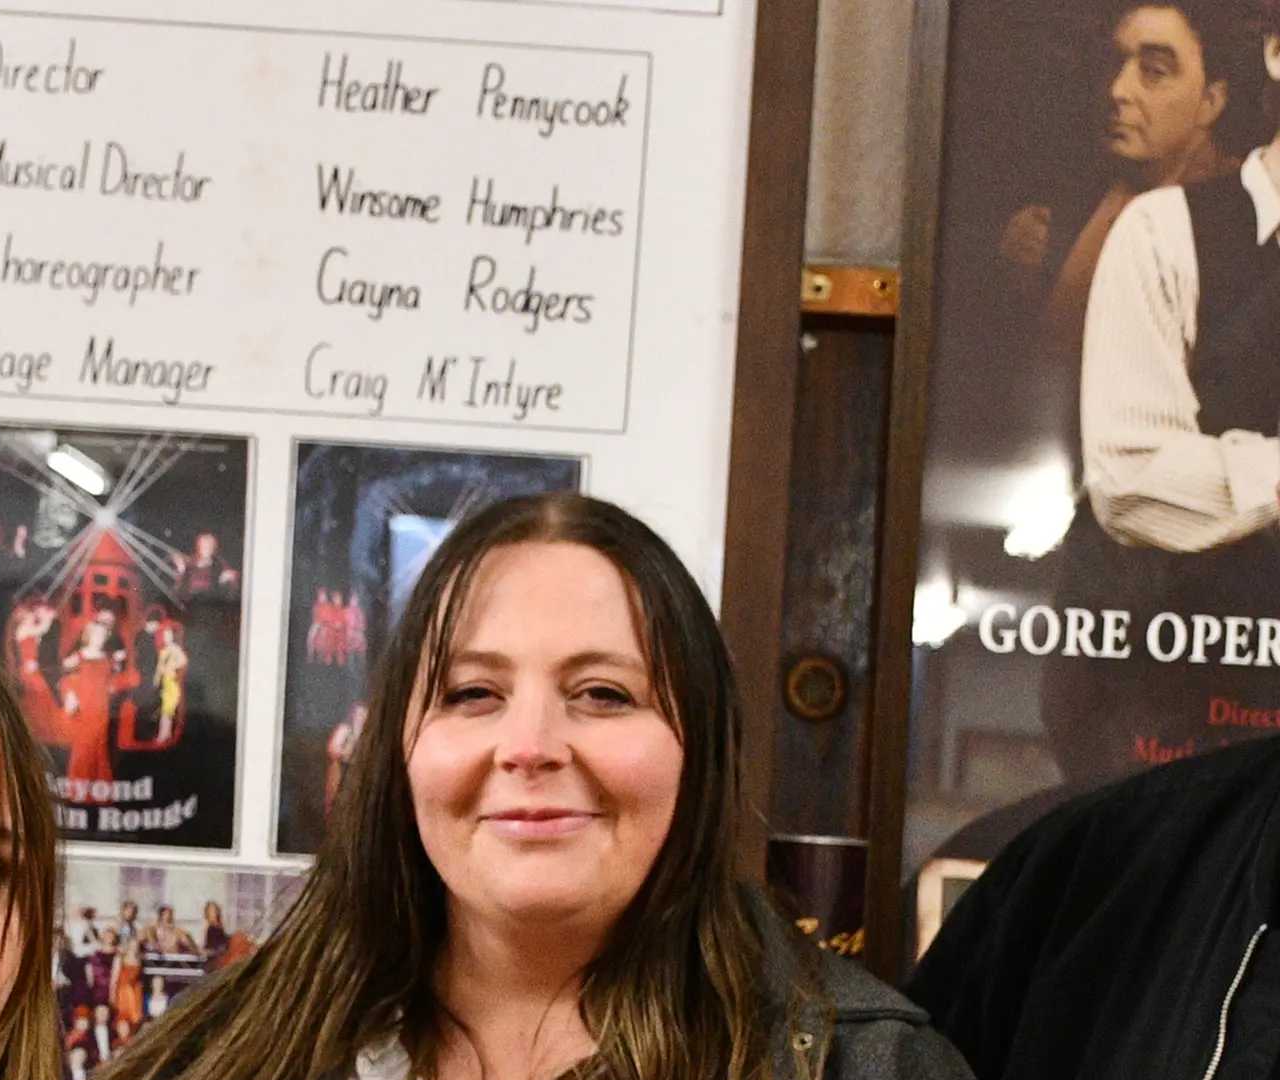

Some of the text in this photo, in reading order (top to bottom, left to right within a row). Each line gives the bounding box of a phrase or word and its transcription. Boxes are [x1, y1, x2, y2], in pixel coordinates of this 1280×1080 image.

[317, 51, 630, 138] Heather Pennycook
[99, 140, 212, 203] Director
[317, 164, 624, 246] Winsome Humphries
[316, 246, 595, 334] Gayna Rodgers
[79, 335, 216, 405] Manager
[304, 341, 389, 417] Craig
[978, 602, 1131, 659] GORE
[97, 794, 198, 831] Rouge
